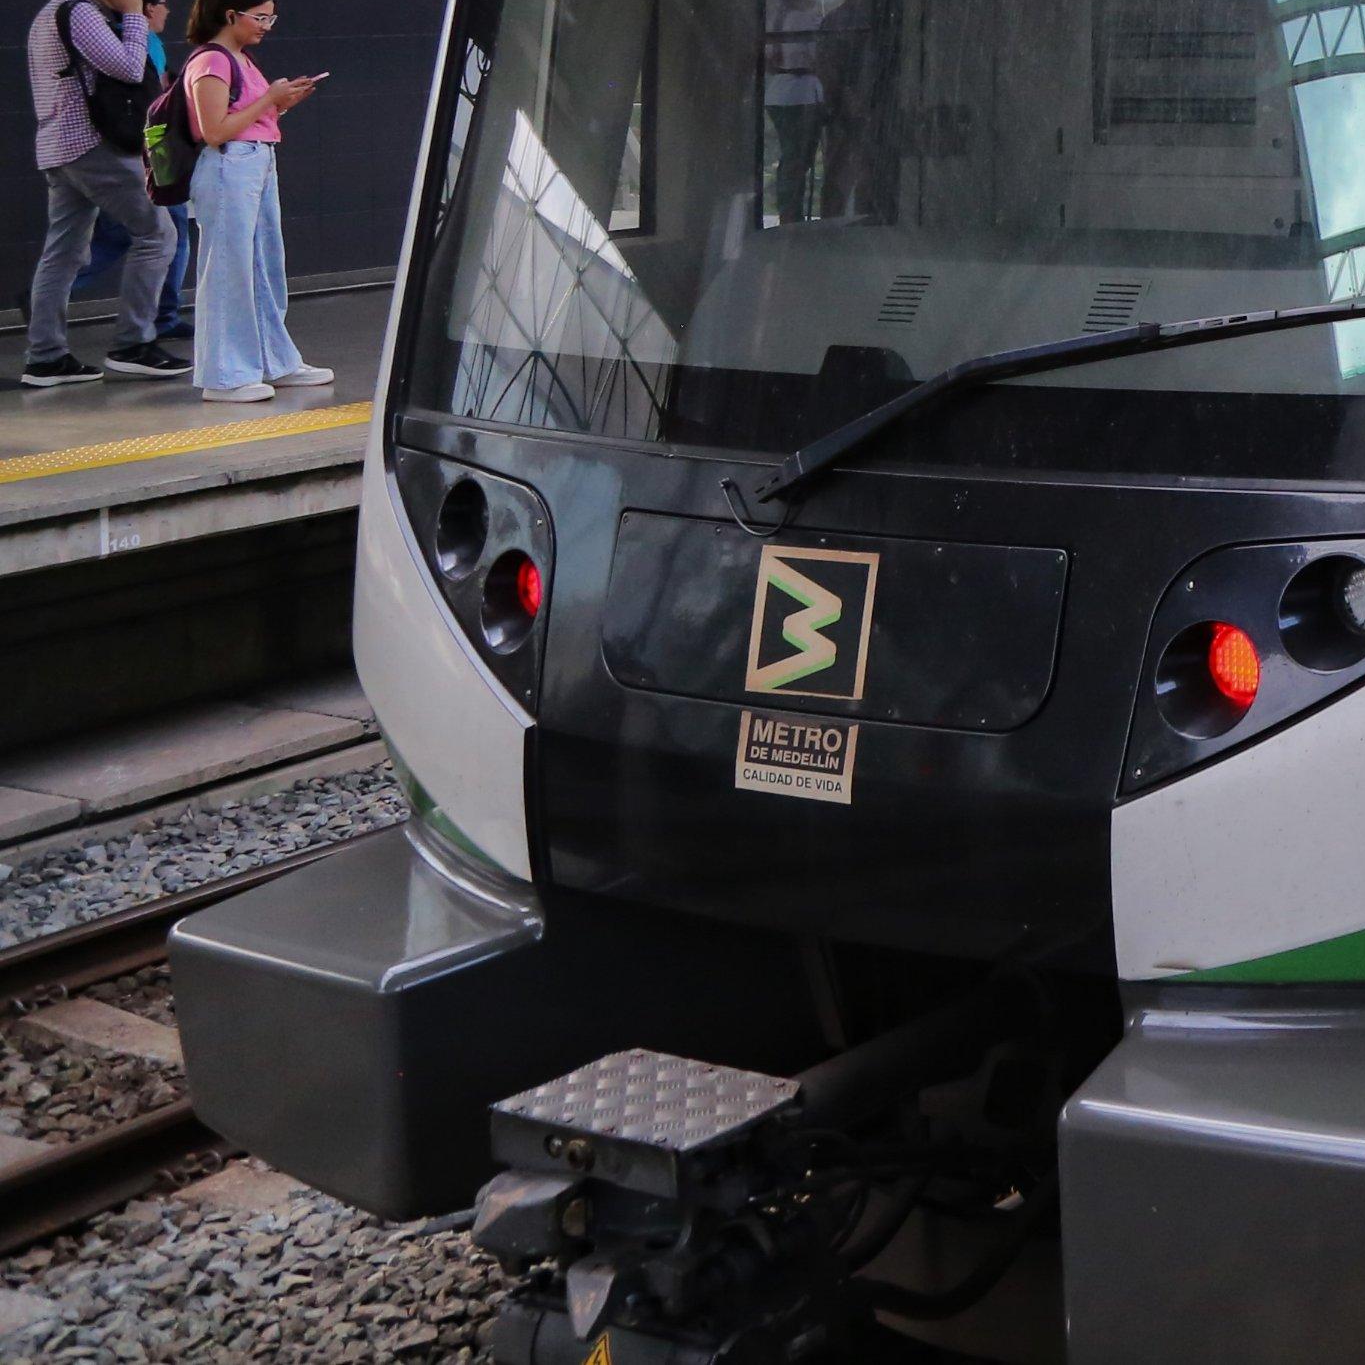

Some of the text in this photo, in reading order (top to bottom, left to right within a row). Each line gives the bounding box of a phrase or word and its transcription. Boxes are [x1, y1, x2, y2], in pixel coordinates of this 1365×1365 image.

[752, 718, 842, 753] METRO
[750, 745, 840, 770] DE MEDELLÍN
[743, 768, 843, 793] CALIDAD DE VIDA
